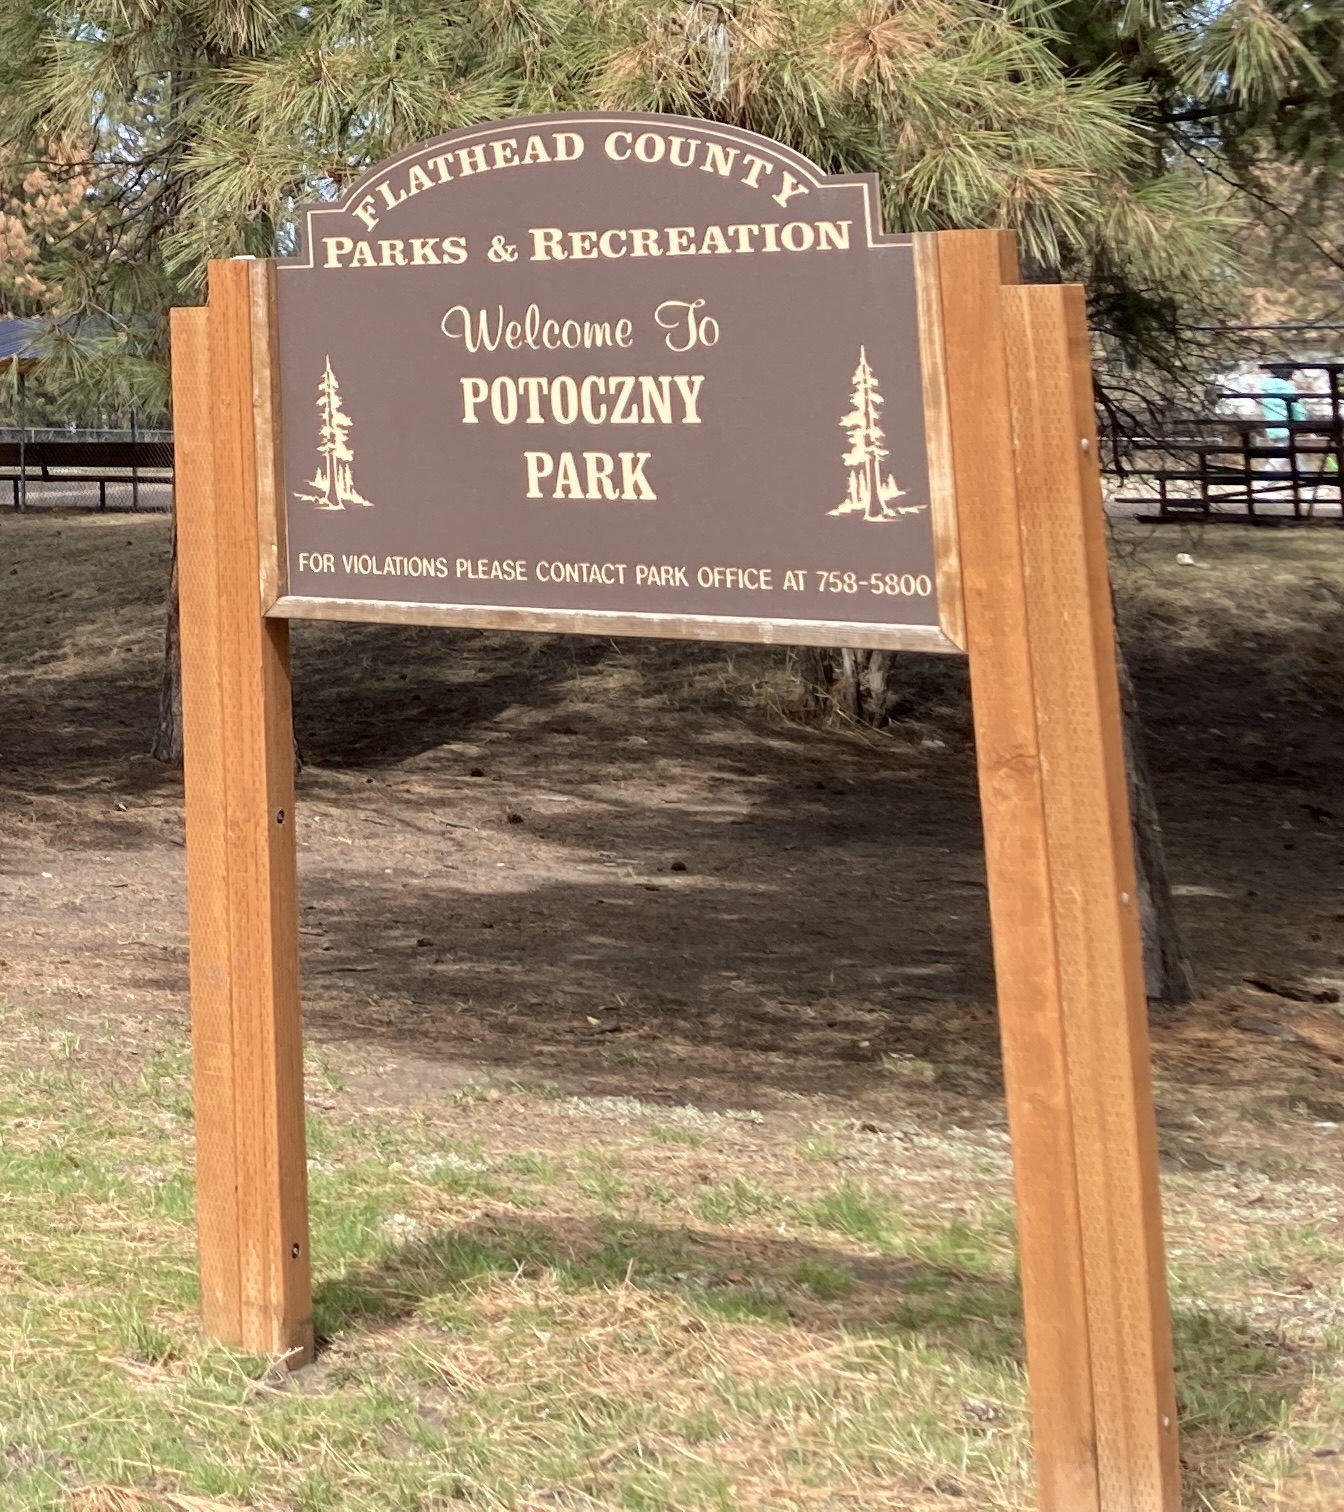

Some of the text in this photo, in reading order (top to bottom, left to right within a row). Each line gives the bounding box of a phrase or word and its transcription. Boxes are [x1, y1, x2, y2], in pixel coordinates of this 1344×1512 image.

[351, 130, 810, 232] FLATHEAD COUNTY
[320, 220, 854, 269] PARKS & RECREATION
[440, 297, 720, 354] Welcome To
[459, 374, 706, 427] POTOCZNY
[523, 450, 658, 503] PARK
[298, 551, 934, 597] FOR VIOLATIONS PLEASE CONTACT PARK OFFICE AT 758-5800
